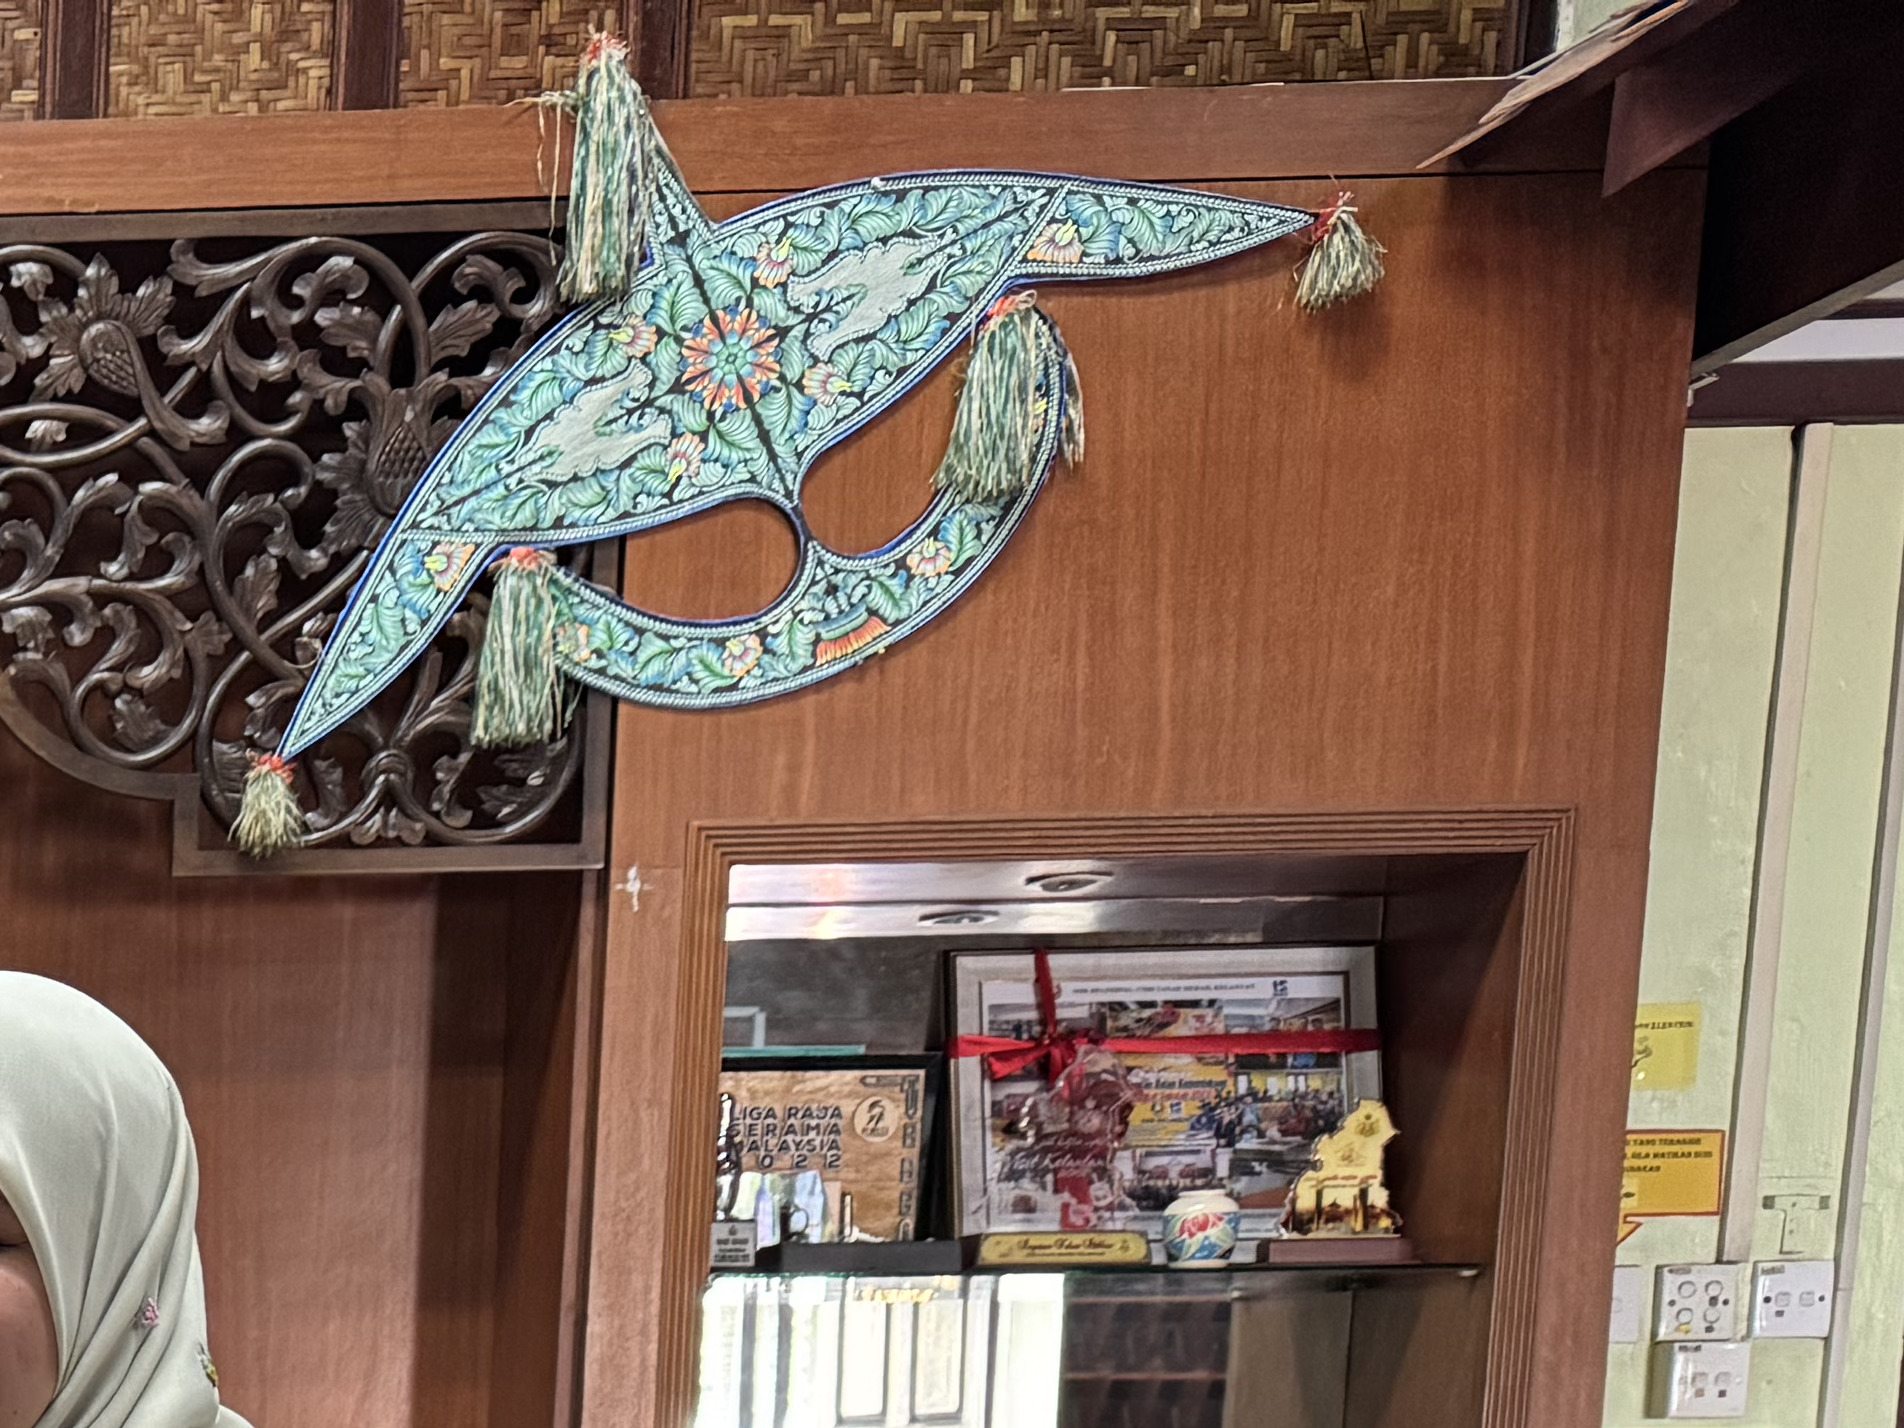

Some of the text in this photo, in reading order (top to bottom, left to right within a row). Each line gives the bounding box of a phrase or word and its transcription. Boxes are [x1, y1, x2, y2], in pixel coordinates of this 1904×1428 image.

[729, 1105, 844, 1121] LIGA RAJA
[728, 1122, 842, 1138] SERAMA
[738, 1138, 842, 1152] ALAYSIA
[758, 1153, 842, 1169] 022
